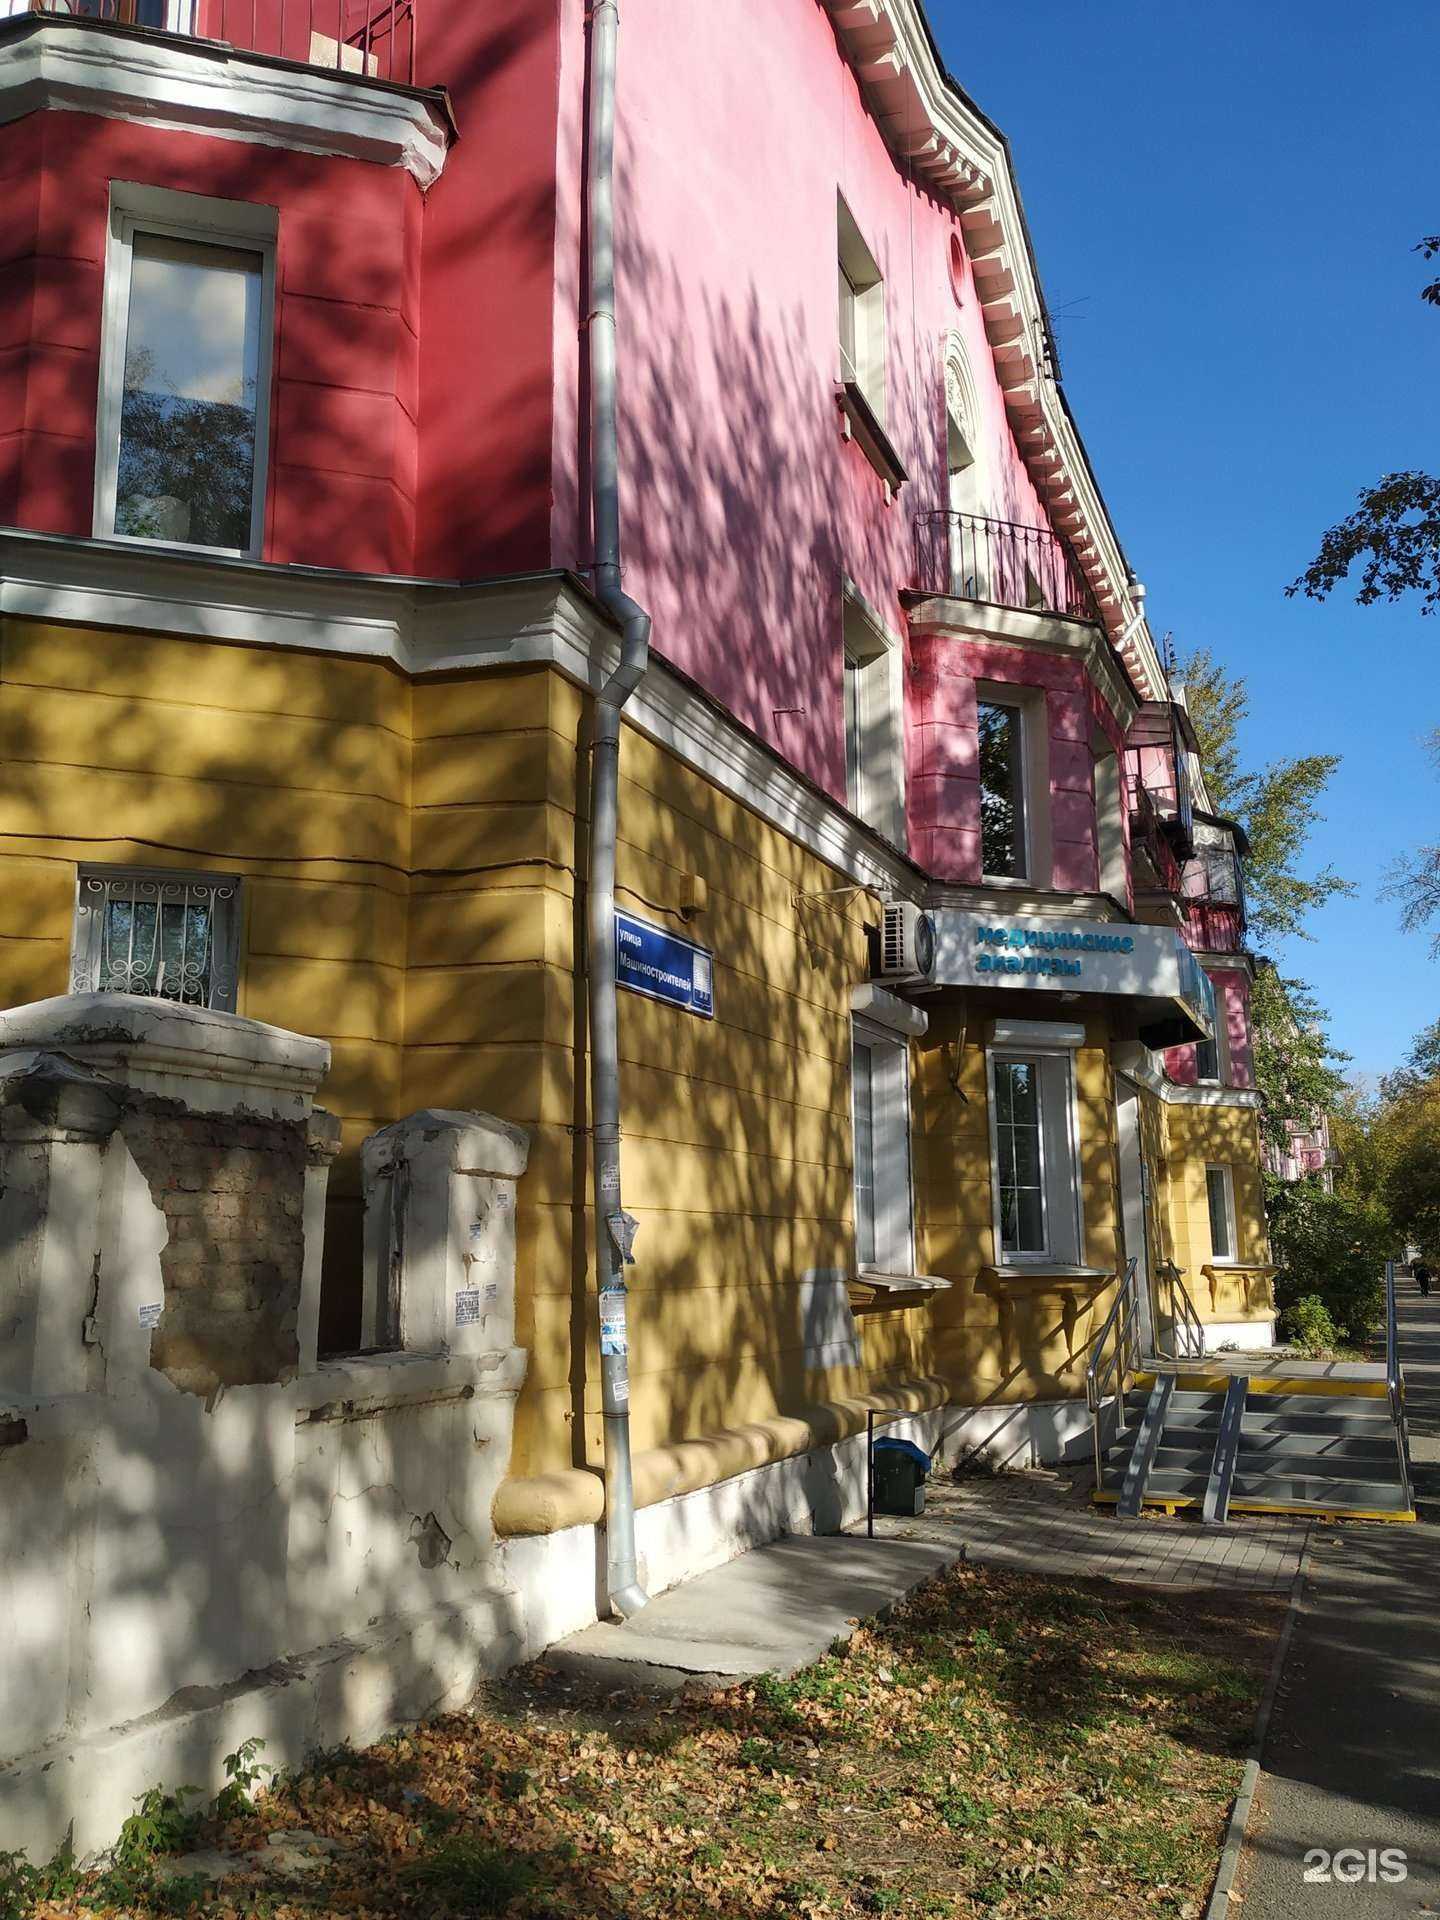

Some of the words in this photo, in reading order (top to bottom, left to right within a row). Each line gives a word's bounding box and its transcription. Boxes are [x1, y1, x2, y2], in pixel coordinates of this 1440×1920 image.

[619, 928, 642, 947] улица
[620, 951, 692, 992] Машиностроителей
[976, 953, 1081, 976] анализы
